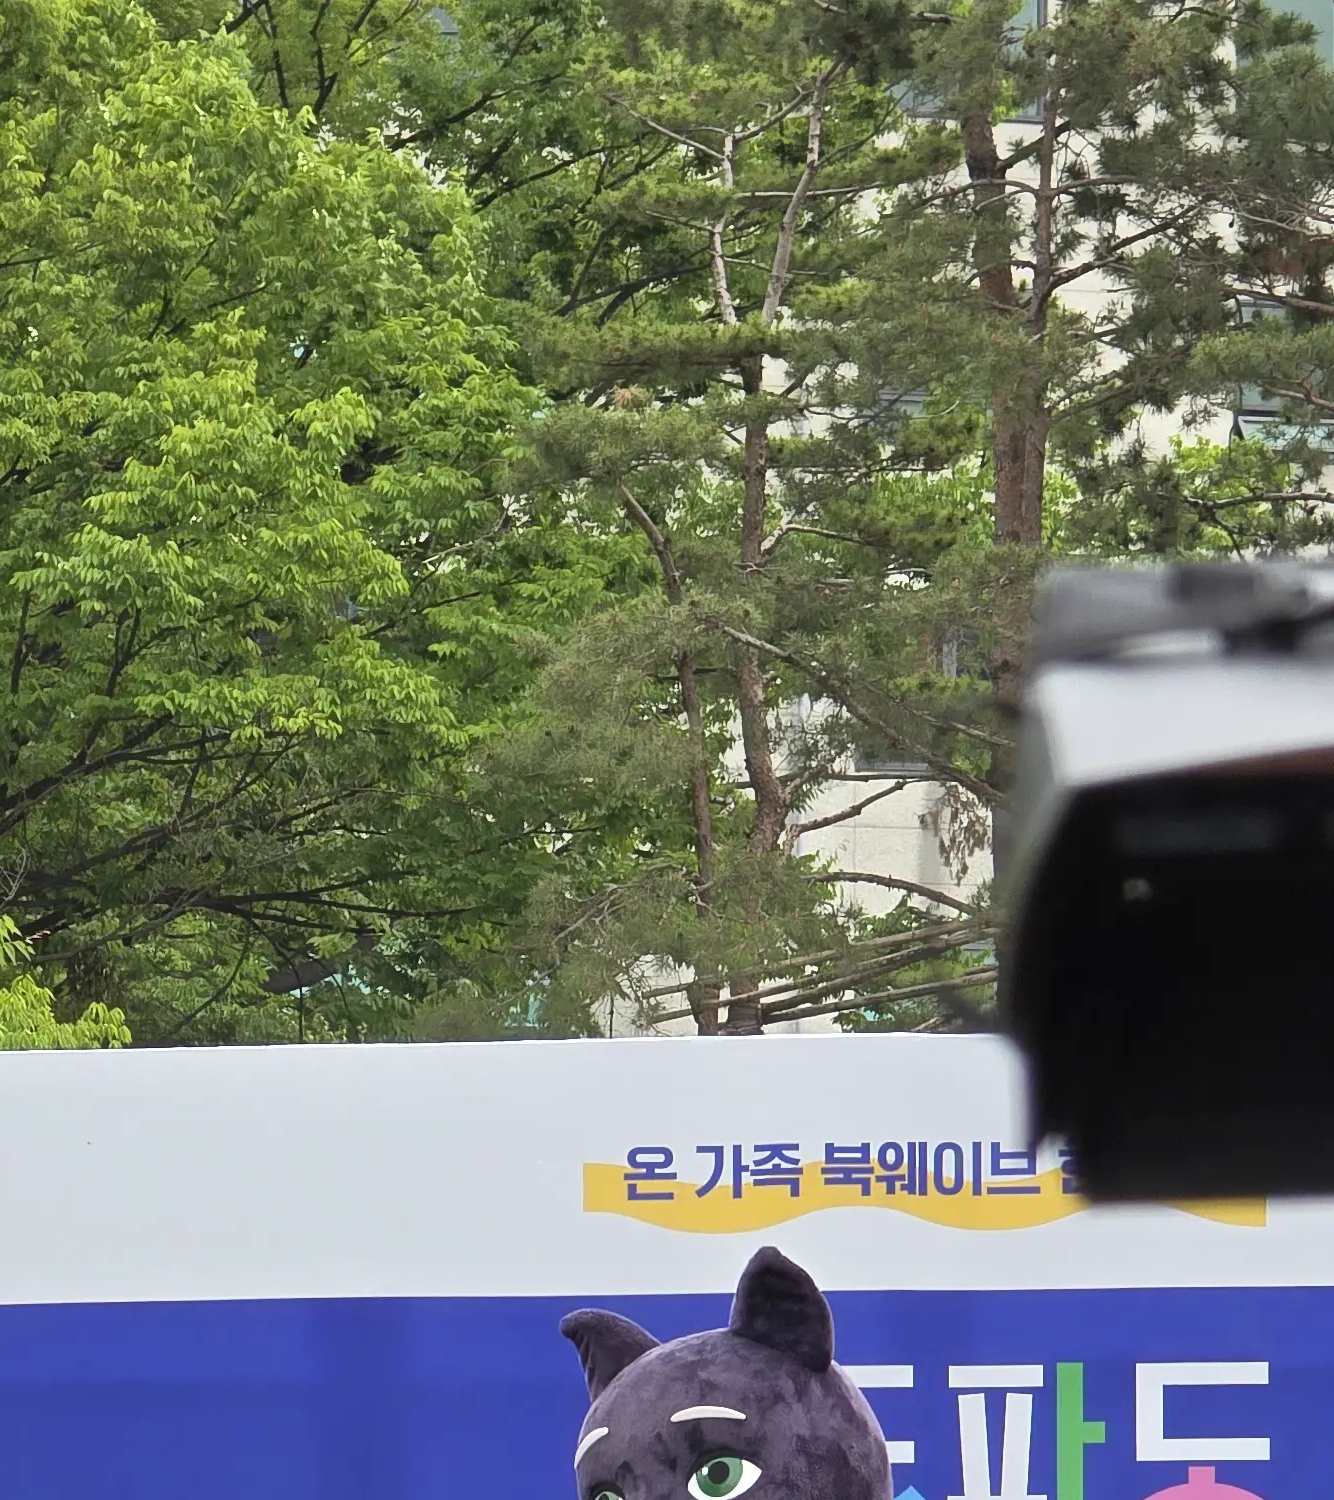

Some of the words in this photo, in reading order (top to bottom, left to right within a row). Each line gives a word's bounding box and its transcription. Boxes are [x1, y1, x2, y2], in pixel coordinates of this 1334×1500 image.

[622, 1146, 677, 1201] 온
[694, 1143, 804, 1199] 가족
[821, 1141, 1041, 1197] 북웨이브
